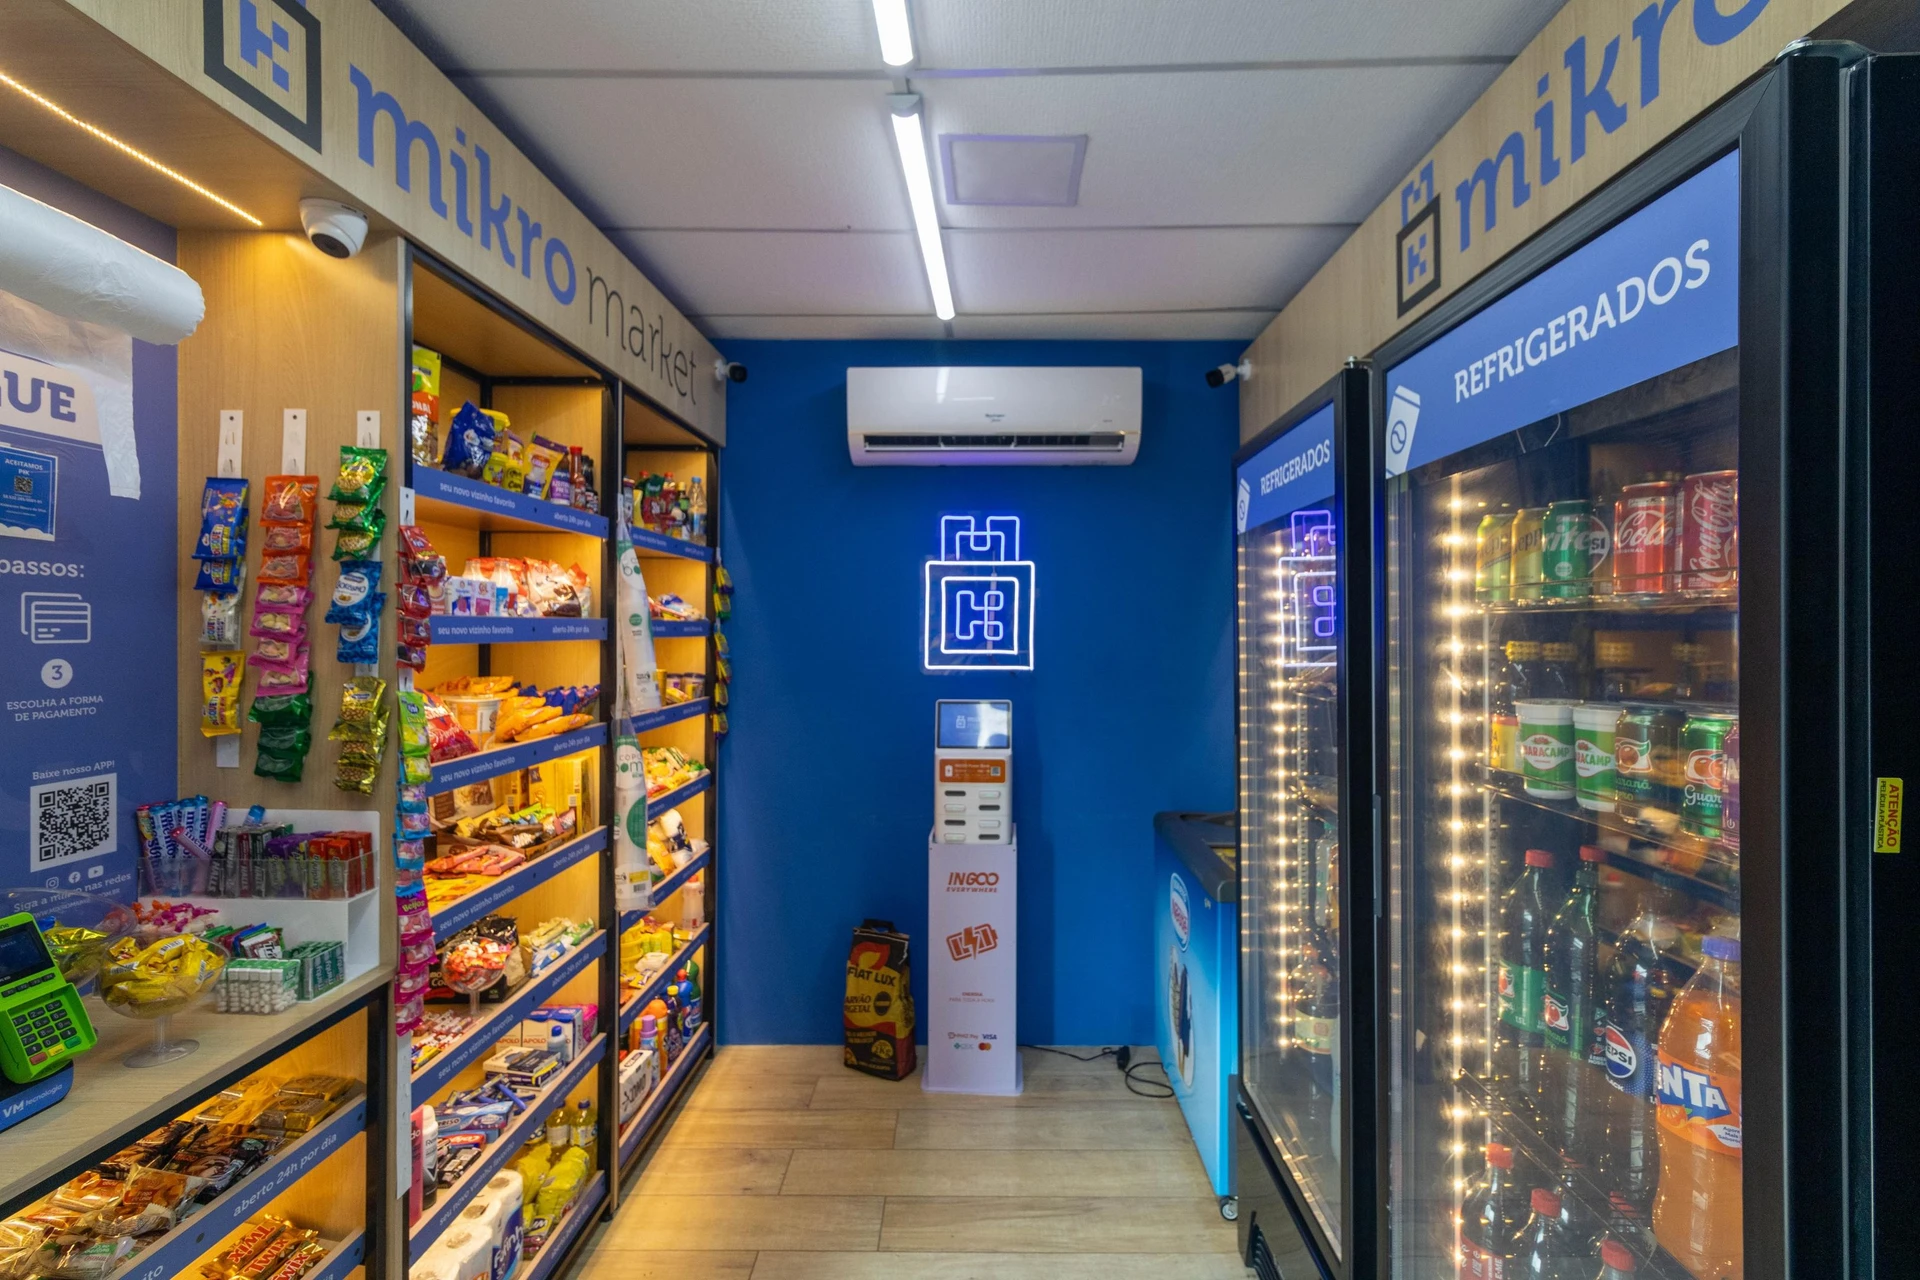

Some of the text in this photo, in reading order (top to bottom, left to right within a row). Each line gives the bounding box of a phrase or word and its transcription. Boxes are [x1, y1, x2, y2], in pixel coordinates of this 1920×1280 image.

[350, 63, 696, 406] mikro market
[1454, 238, 1711, 403] REFRIGERADOS
[0, 370, 76, 423] UE
[5, 458, 43, 470] ACEITAMOS
[1260, 439, 1330, 496] REFRIGERADOS
[440, 482, 516, 509] seu novo vizinho favorito
[438, 625, 514, 635] seu novo vizinho favorito
[51, 665, 63, 680] 3
[6, 694, 104, 711] ESCOLHA A FORMA
[15, 706, 97, 722] DE PAGAMENTO
[32, 759, 115, 781] Baixe nosso APP!
[440, 756, 515, 783] seu novo vizinho favorito
[1684, 784, 1722, 806] Guar
[1879, 780, 1887, 814] PELÍCULA
[1887, 784, 1899, 847] ATENÇÃO
[208, 861, 220, 892] HALLS
[948, 871, 999, 886] INGOO
[13, 900, 39, 913] Siga
[85, 880, 103, 893] nas
[105, 872, 132, 887] redes
[440, 884, 515, 931] seu novo vizinho favorito
[847, 966, 896, 987] FIAT LUX
[845, 993, 872, 1004] ARVÃO
[438, 1014, 515, 1079] seu novo vizinho favorito
[1605, 1074, 1624, 1092] LACK
[3, 1100, 24, 1118] VM
[233, 1133, 337, 1217] aberto 24h por dia
[243, 1239, 290, 1273] TWIX
